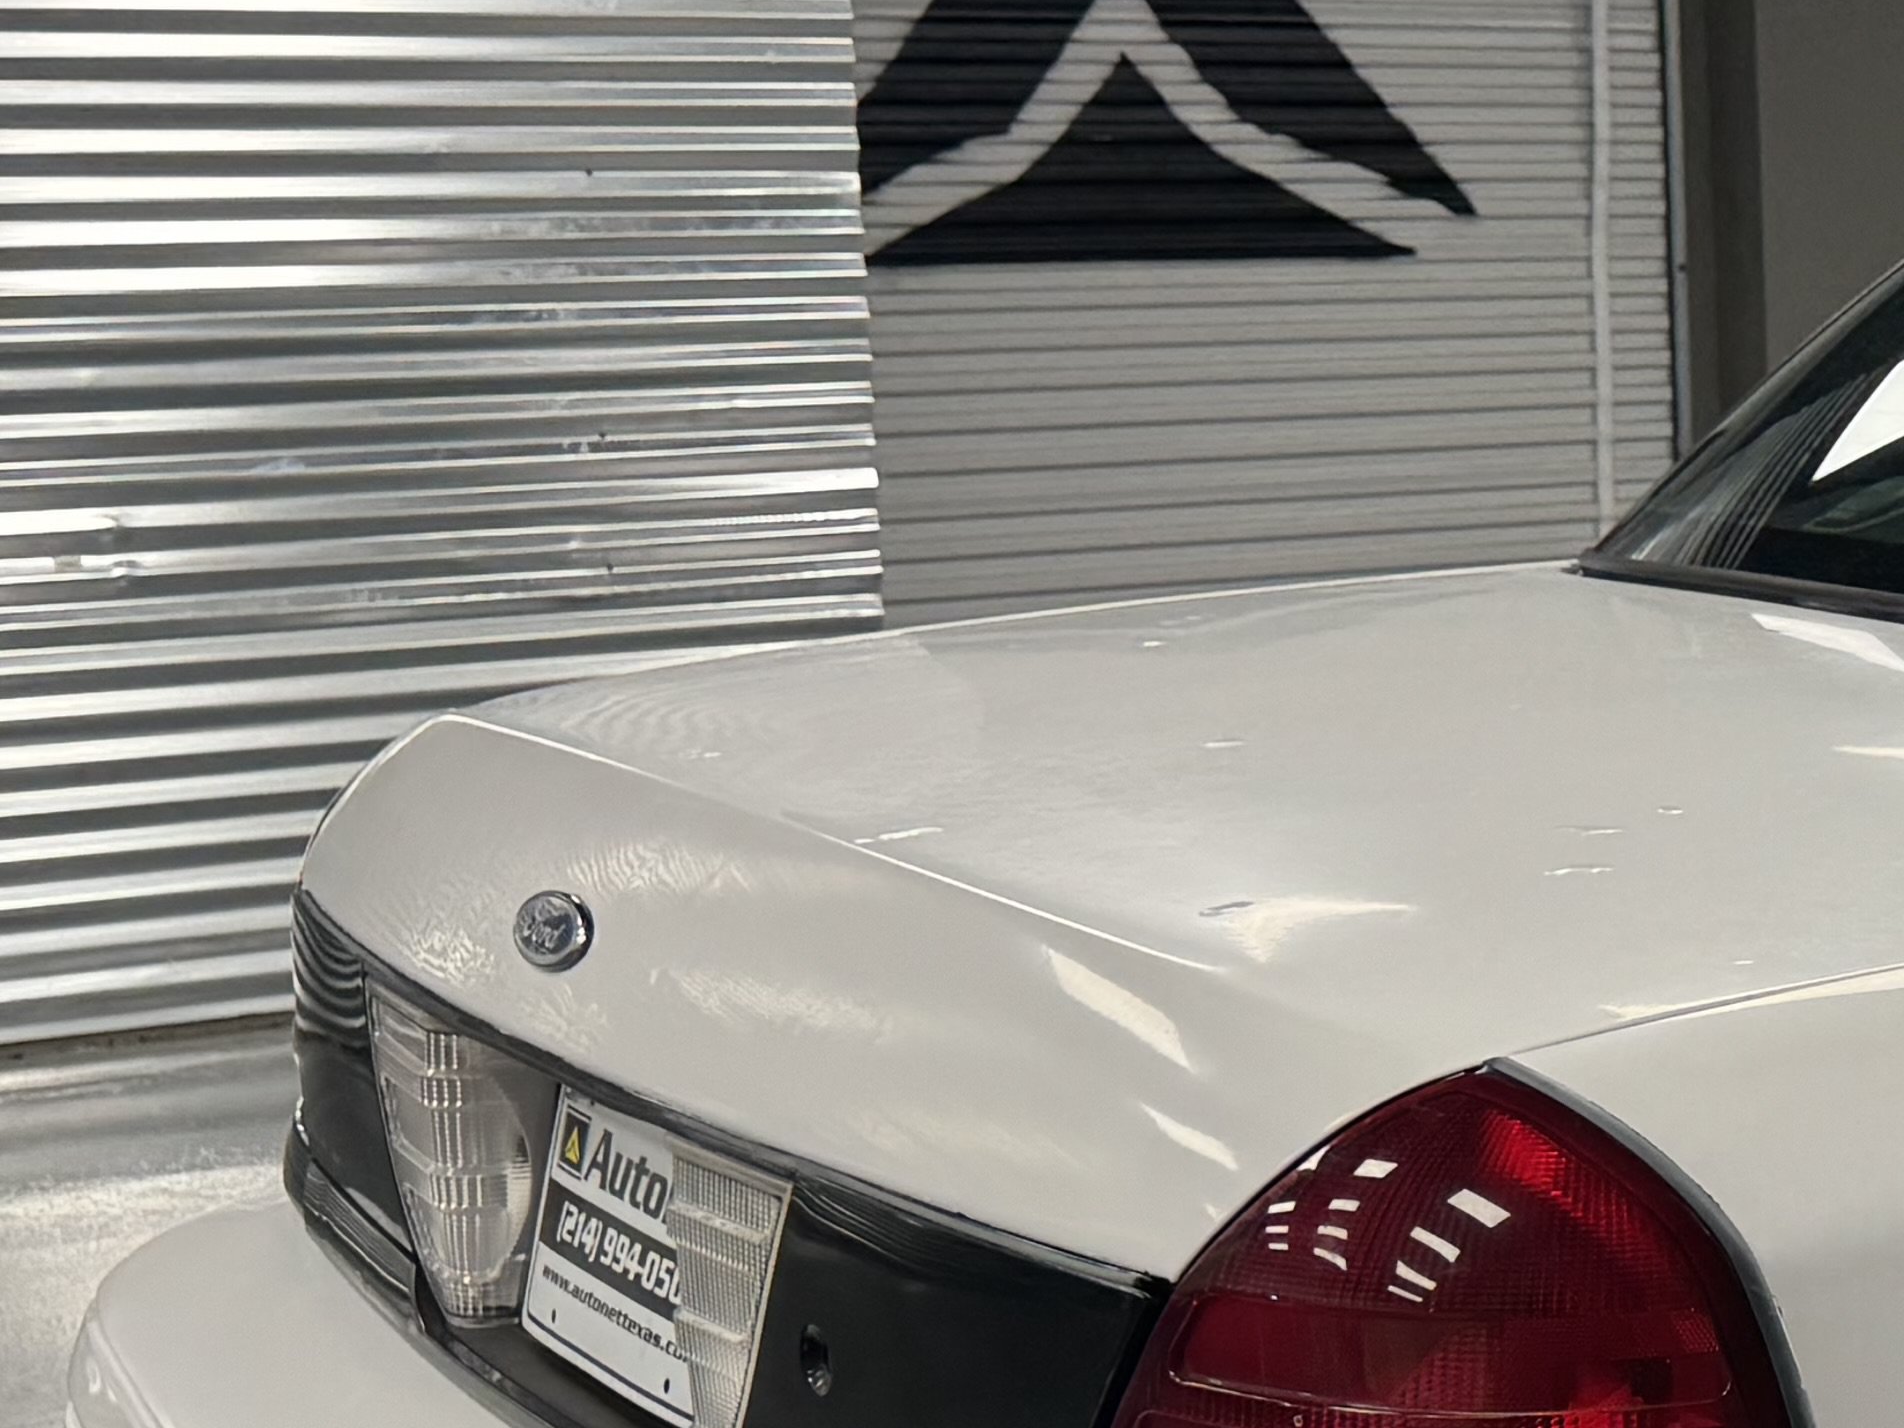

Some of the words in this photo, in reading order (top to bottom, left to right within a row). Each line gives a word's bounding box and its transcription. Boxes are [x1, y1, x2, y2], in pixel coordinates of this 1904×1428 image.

[519, 901, 566, 951] Ford
[583, 1128, 672, 1222] Auto
[557, 1200, 603, 1262] (214)
[542, 1264, 688, 1363] www.autonettexas.co
